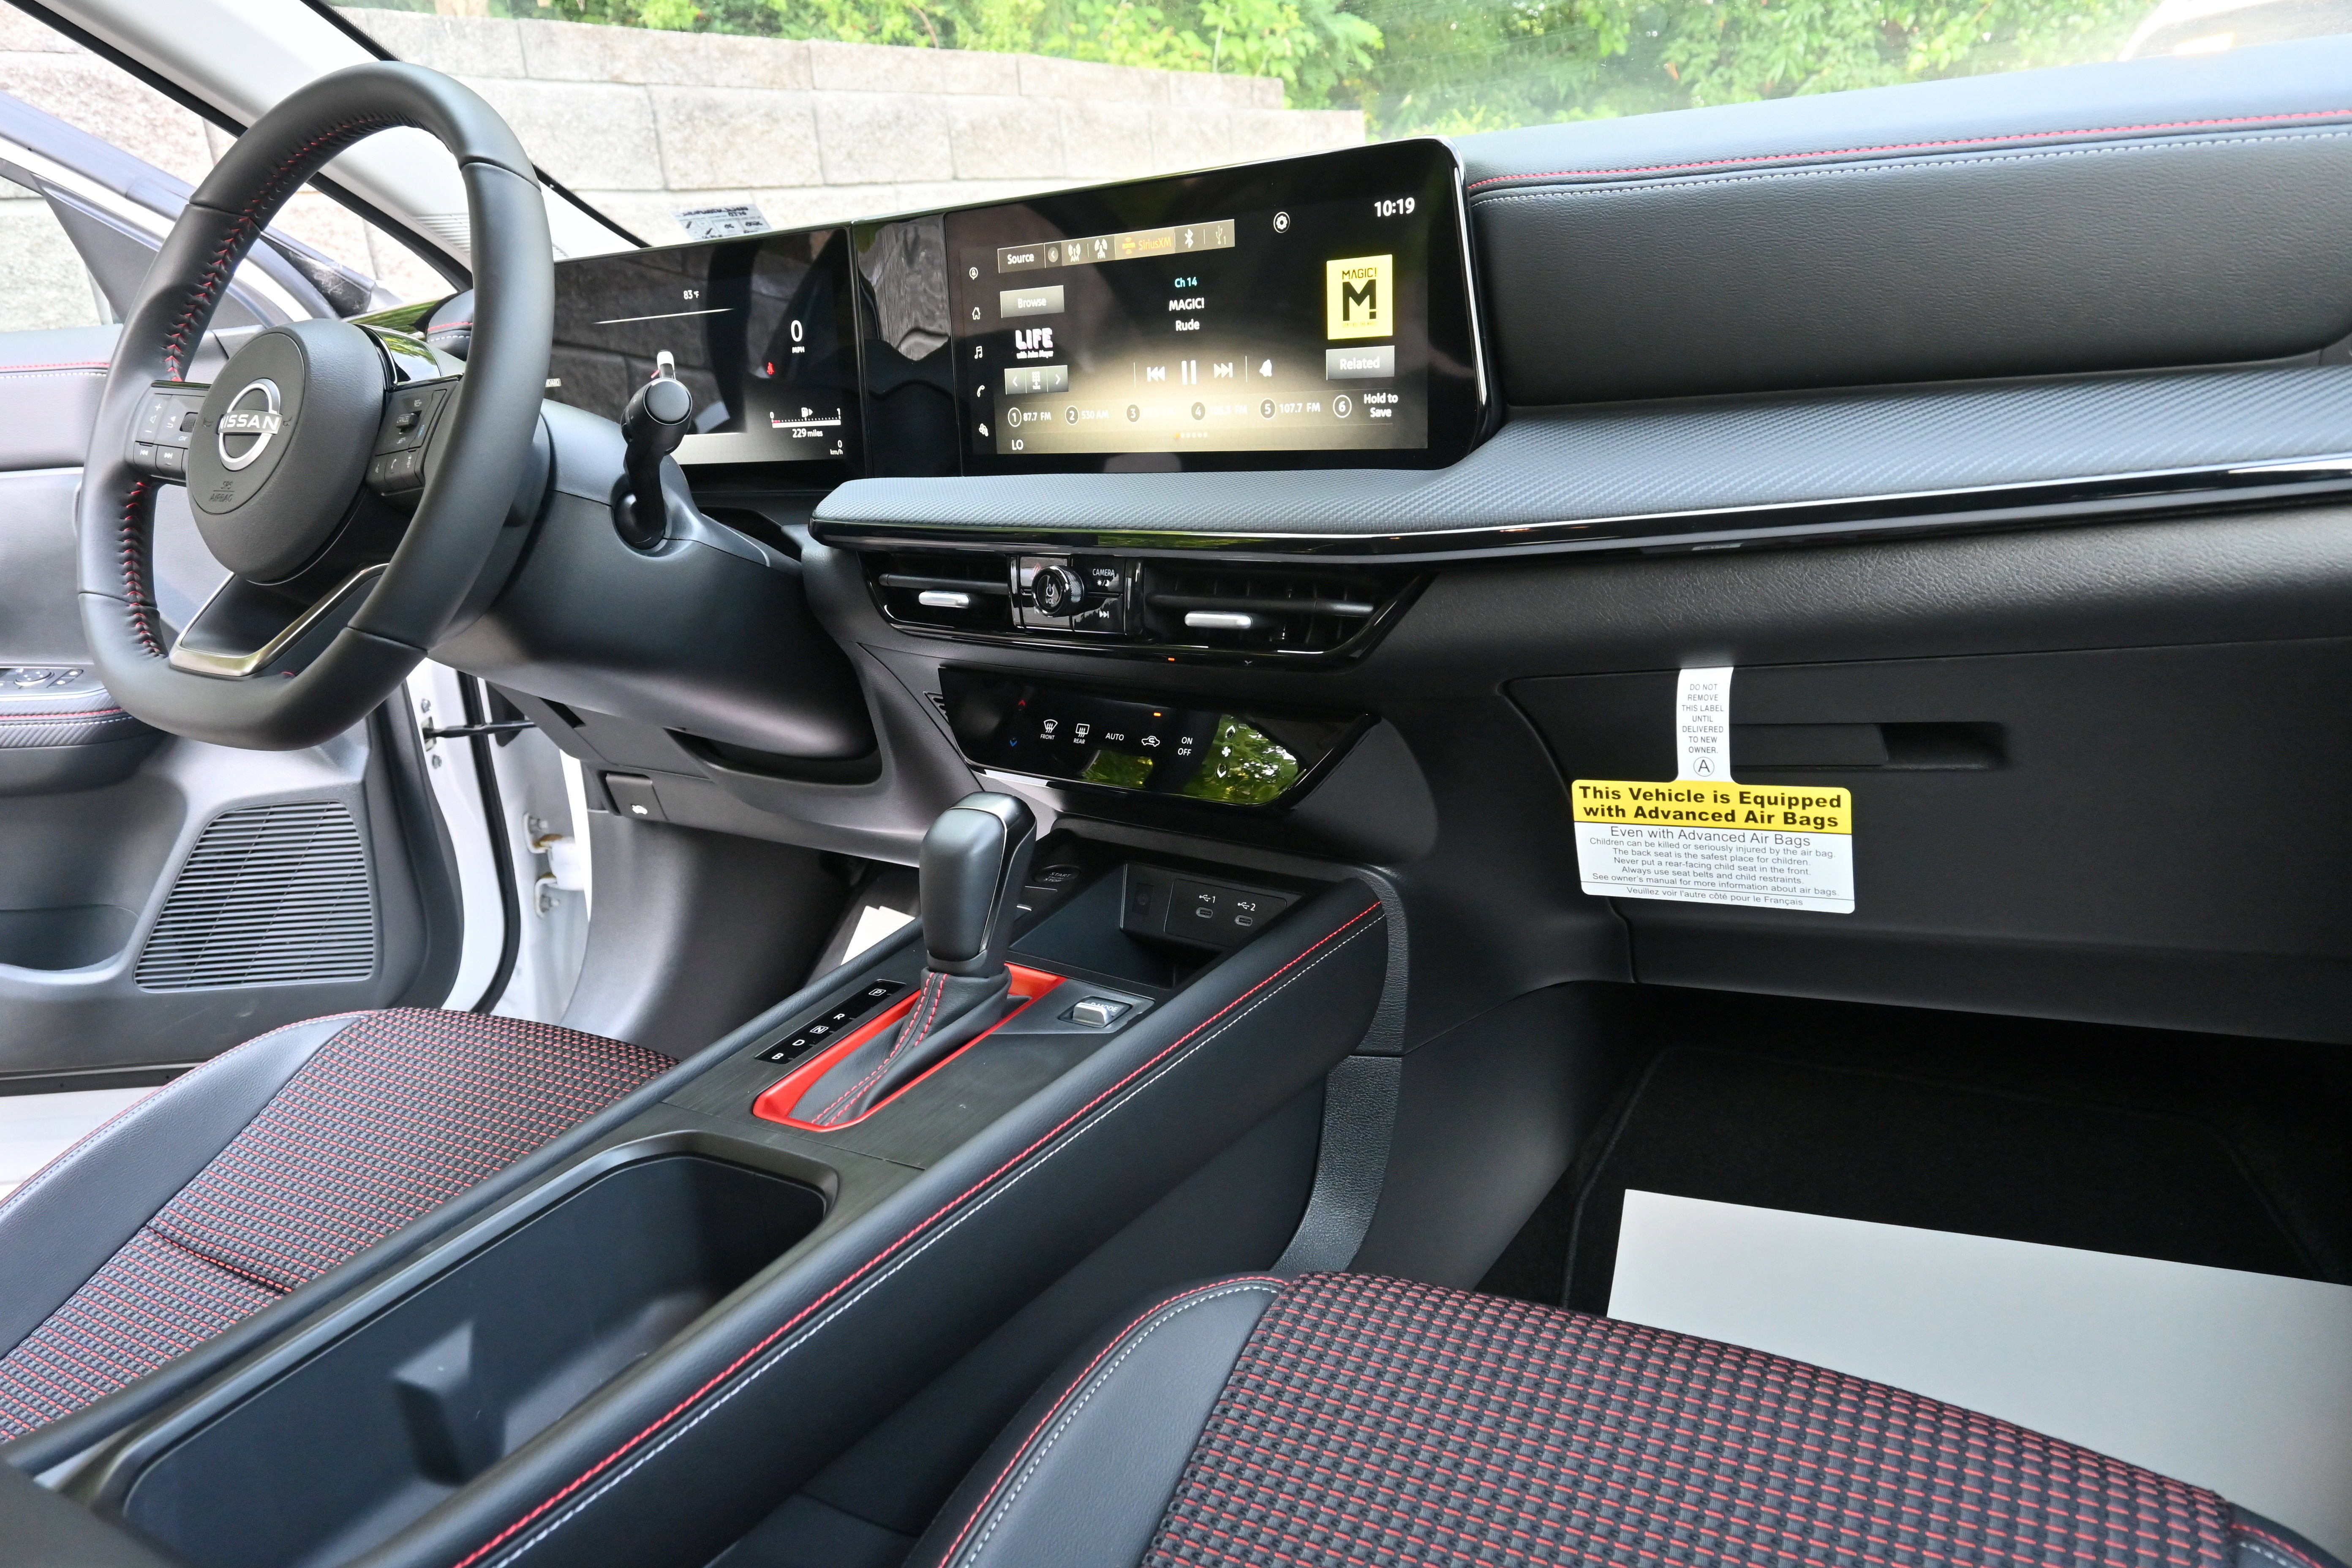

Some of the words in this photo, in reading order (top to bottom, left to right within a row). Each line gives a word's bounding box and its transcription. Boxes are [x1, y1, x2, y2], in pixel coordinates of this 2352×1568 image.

[1374, 197, 1415, 217] 10:19
[1138, 237, 1171, 250] SiriusXM
[1007, 253, 1034, 265] Source
[1342, 267, 1377, 280] MAGIC!
[1175, 278, 1185, 288] Ch
[1187, 277, 1198, 286] 14
[683, 290, 693, 299] 83
[1018, 298, 1047, 308] Browse
[1169, 297, 1204, 311] MAGIC!
[1176, 318, 1200, 331] Rude
[791, 320, 803, 342] 0
[1015, 327, 1053, 350] LIFE
[1339, 356, 1380, 370] Related
[1338, 401, 1346, 412] 6
[1364, 392, 1386, 404] Hold
[1388, 393, 1399, 403] to
[1130, 408, 1136, 418] 3
[1195, 406, 1202, 416] 4
[1234, 405, 1247, 414] FM
[1265, 403, 1271, 414] 5
[1279, 403, 1303, 413] 107.7
[1307, 403, 1320, 412] FM
[1370, 407, 1392, 418] Save
[1012, 412, 1017, 422] 1
[1023, 412, 1038, 421] 87.7
[1040, 412, 1051, 421] FM
[1069, 411, 1075, 420] 2
[1081, 410, 1095, 419] 530
[1096, 410, 1109, 419] AM
[218, 414, 280, 430] NISSAN
[792, 428, 806, 438] 229
[807, 429, 823, 437] miles
[838, 440, 842, 448] 0
[1012, 439, 1024, 450] LO
[1092, 569, 1115, 577] CAMERA
[1105, 732, 1124, 741] AUTO
[1178, 748, 1192, 756] OFF
[1698, 759, 1710, 773] A
[1579, 786, 1621, 800] This
[1628, 788, 1704, 803] Vehicle
[1713, 790, 1730, 803] is
[1740, 791, 1840, 810] Equipped
[1583, 804, 1625, 817] with
[1634, 806, 1735, 822] Advanced
[1745, 810, 1775, 824] Air
[1783, 812, 1838, 830] Bags
[1611, 826, 1643, 838] Even
[1647, 828, 1674, 839] with
[1678, 829, 1745, 842] Advanced
[1750, 833, 1769, 844] Air
[1775, 834, 1810, 848] Bags
[1590, 838, 1624, 846] Children
[1694, 844, 1733, 853] seriously
[1736, 845, 1766, 854] injured
[1769, 847, 1780, 856] by
[1816, 849, 1835, 859] bag.
[1666, 861, 1711, 870] rear-facing
[1730, 855, 1754, 863] place
[1772, 857, 1810, 865] children.
[1622, 866, 1651, 875] Always
[1719, 881, 1768, 890] information
[1814, 888, 1839, 897] bags.
[1627, 887, 1659, 895] Veuillez
[1709, 892, 1728, 900] côté
[1764, 896, 1803, 906] Français
[1250, 903, 1256, 911] 2
